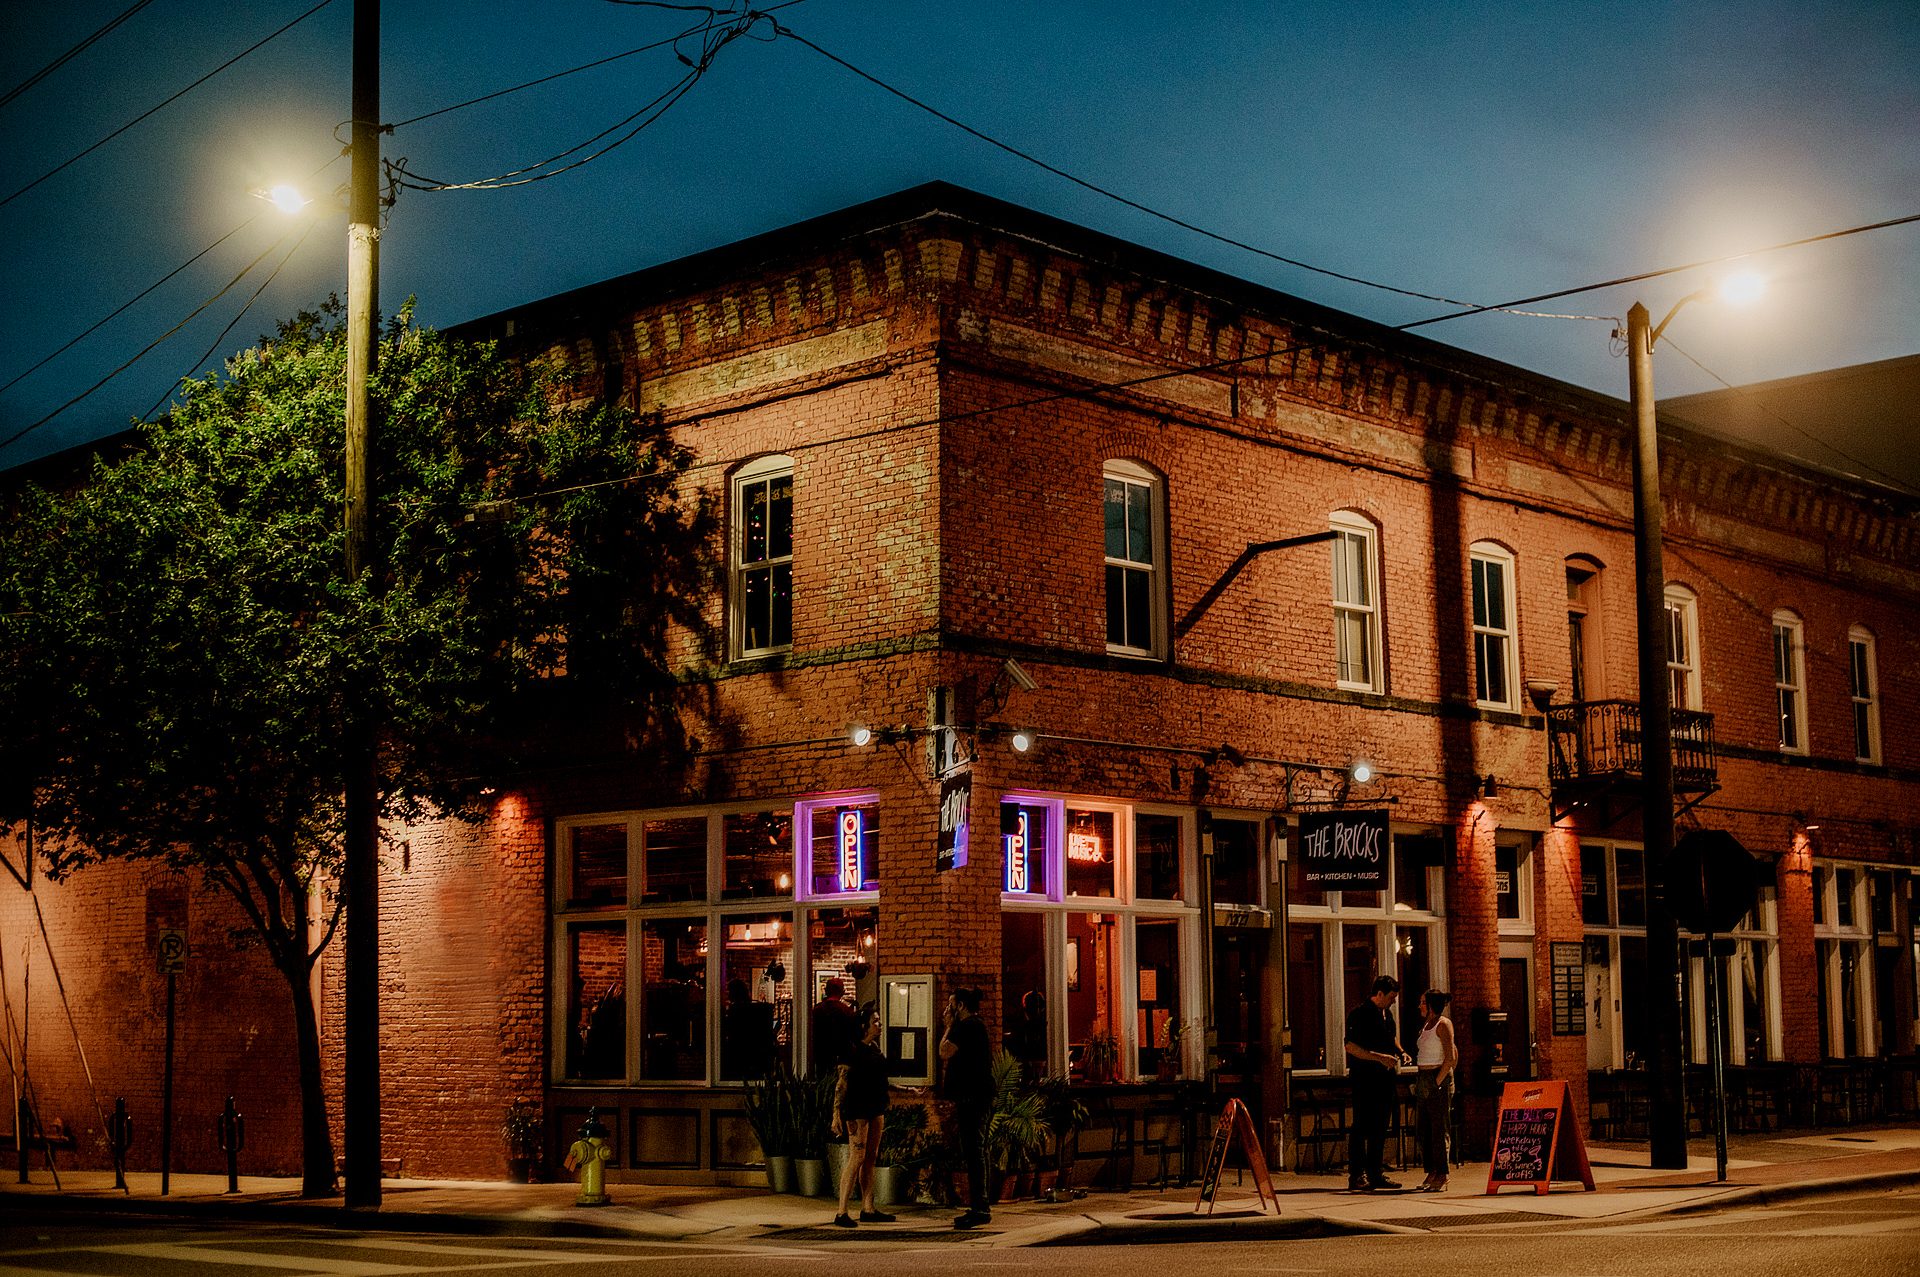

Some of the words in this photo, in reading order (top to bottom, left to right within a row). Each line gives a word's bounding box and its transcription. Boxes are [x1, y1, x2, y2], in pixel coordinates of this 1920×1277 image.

[1304, 825, 1331, 858] THE
[1333, 821, 1383, 863] BRICKS
[843, 814, 857, 888] OPEN
[1306, 873, 1320, 881] BAR
[1324, 872, 1352, 880] KITCHEN
[1357, 871, 1379, 880] MUSIC
[1230, 913, 1249, 926] 1327
[1505, 1110, 1519, 1120] THE
[1507, 1122, 1529, 1135] HAPPY
[1530, 1122, 1547, 1135] HOUR
[1499, 1136, 1541, 1146] weekdays
[1511, 1152, 1522, 1162] $5
[1506, 1170, 1534, 1180] drafts
